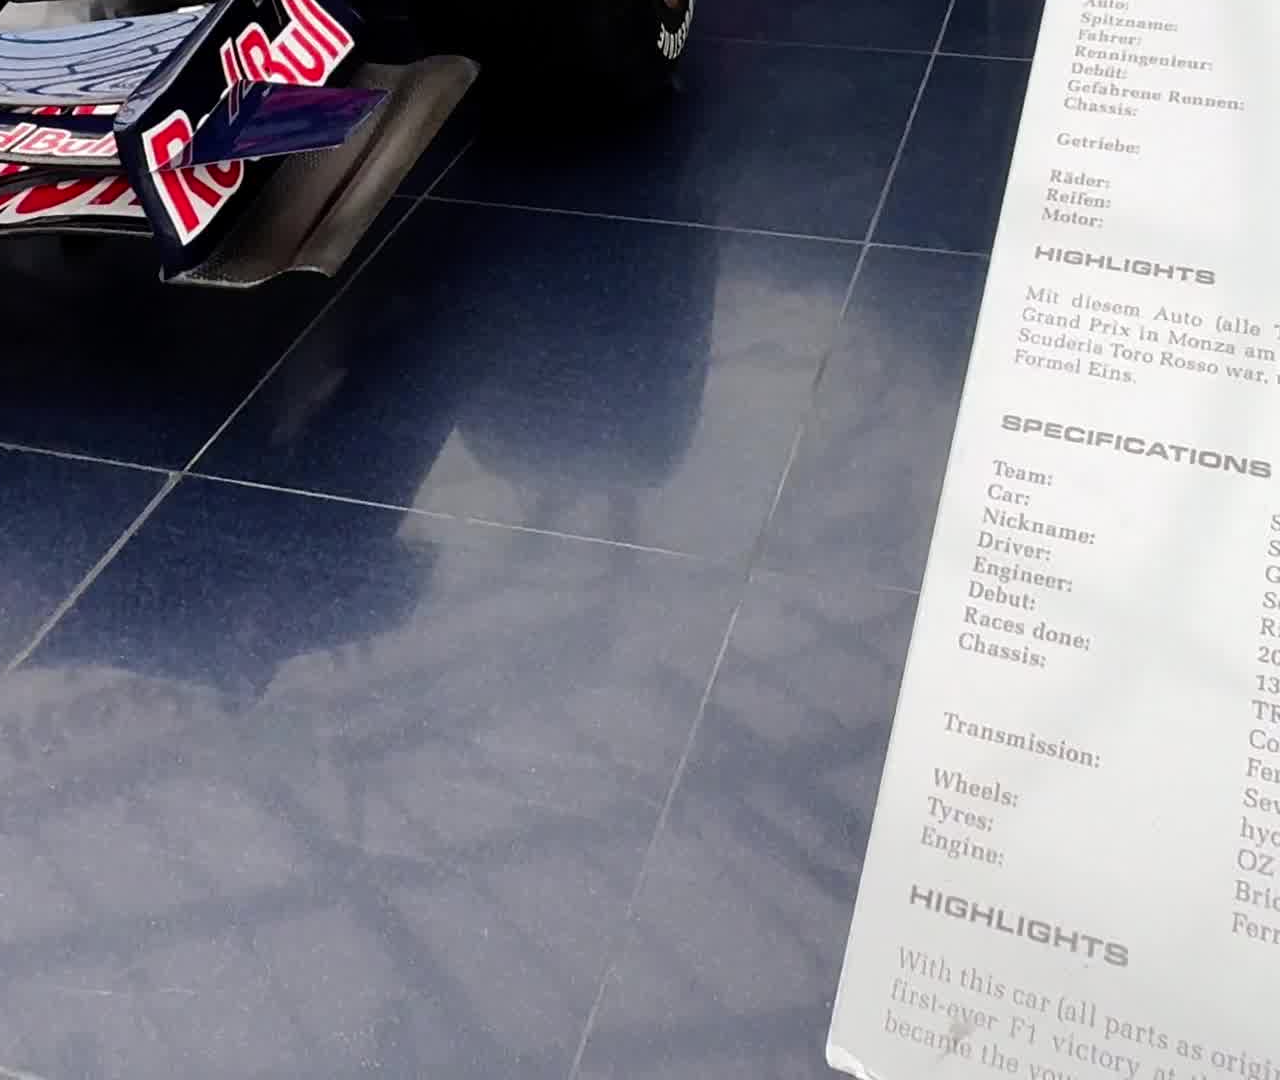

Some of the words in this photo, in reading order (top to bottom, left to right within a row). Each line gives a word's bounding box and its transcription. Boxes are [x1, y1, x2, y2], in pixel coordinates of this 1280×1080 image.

[1077, 26, 1143, 45] Fahrer:
[1079, 11, 1178, 31] Spitzname:
[1071, 60, 1128, 79] Debüt:
[1074, 45, 1213, 70] Renningenieur:
[1063, 96, 1139, 116] Chassis:
[1066, 79, 1163, 100] Gefahrene
[1167, 90, 1245, 110] Rennen:
[1056, 132, 1141, 153] Getriebe:
[1049, 169, 1111, 188] Räder:
[1045, 187, 1112, 208] Reifen:
[1041, 207, 1104, 227] Motor:
[1034, 246, 1216, 284] HIGHLIGHTS
[1000, 415, 1272, 478] SPECIFICATIONS
[992, 459, 1053, 485] Team:
[987, 484, 1031, 506] Car:
[982, 507, 1096, 544] Nickname:
[976, 531, 1052, 560] Driver:
[972, 555, 1073, 591] Engineer:
[967, 580, 1036, 610] Debut:
[963, 605, 1025, 635] Races
[1031, 621, 1091, 650] done:
[958, 633, 1047, 667] Chassis:
[1257, 675, 1280, 694] 13
[944, 713, 1101, 767] Transmission:
[934, 768, 1019, 806] Wheels:
[927, 795, 994, 831] Tyres:
[920, 827, 1004, 865] Engine:
[1239, 851, 1275, 877] OZ
[909, 885, 1129, 965] HIGHLIGHTS
